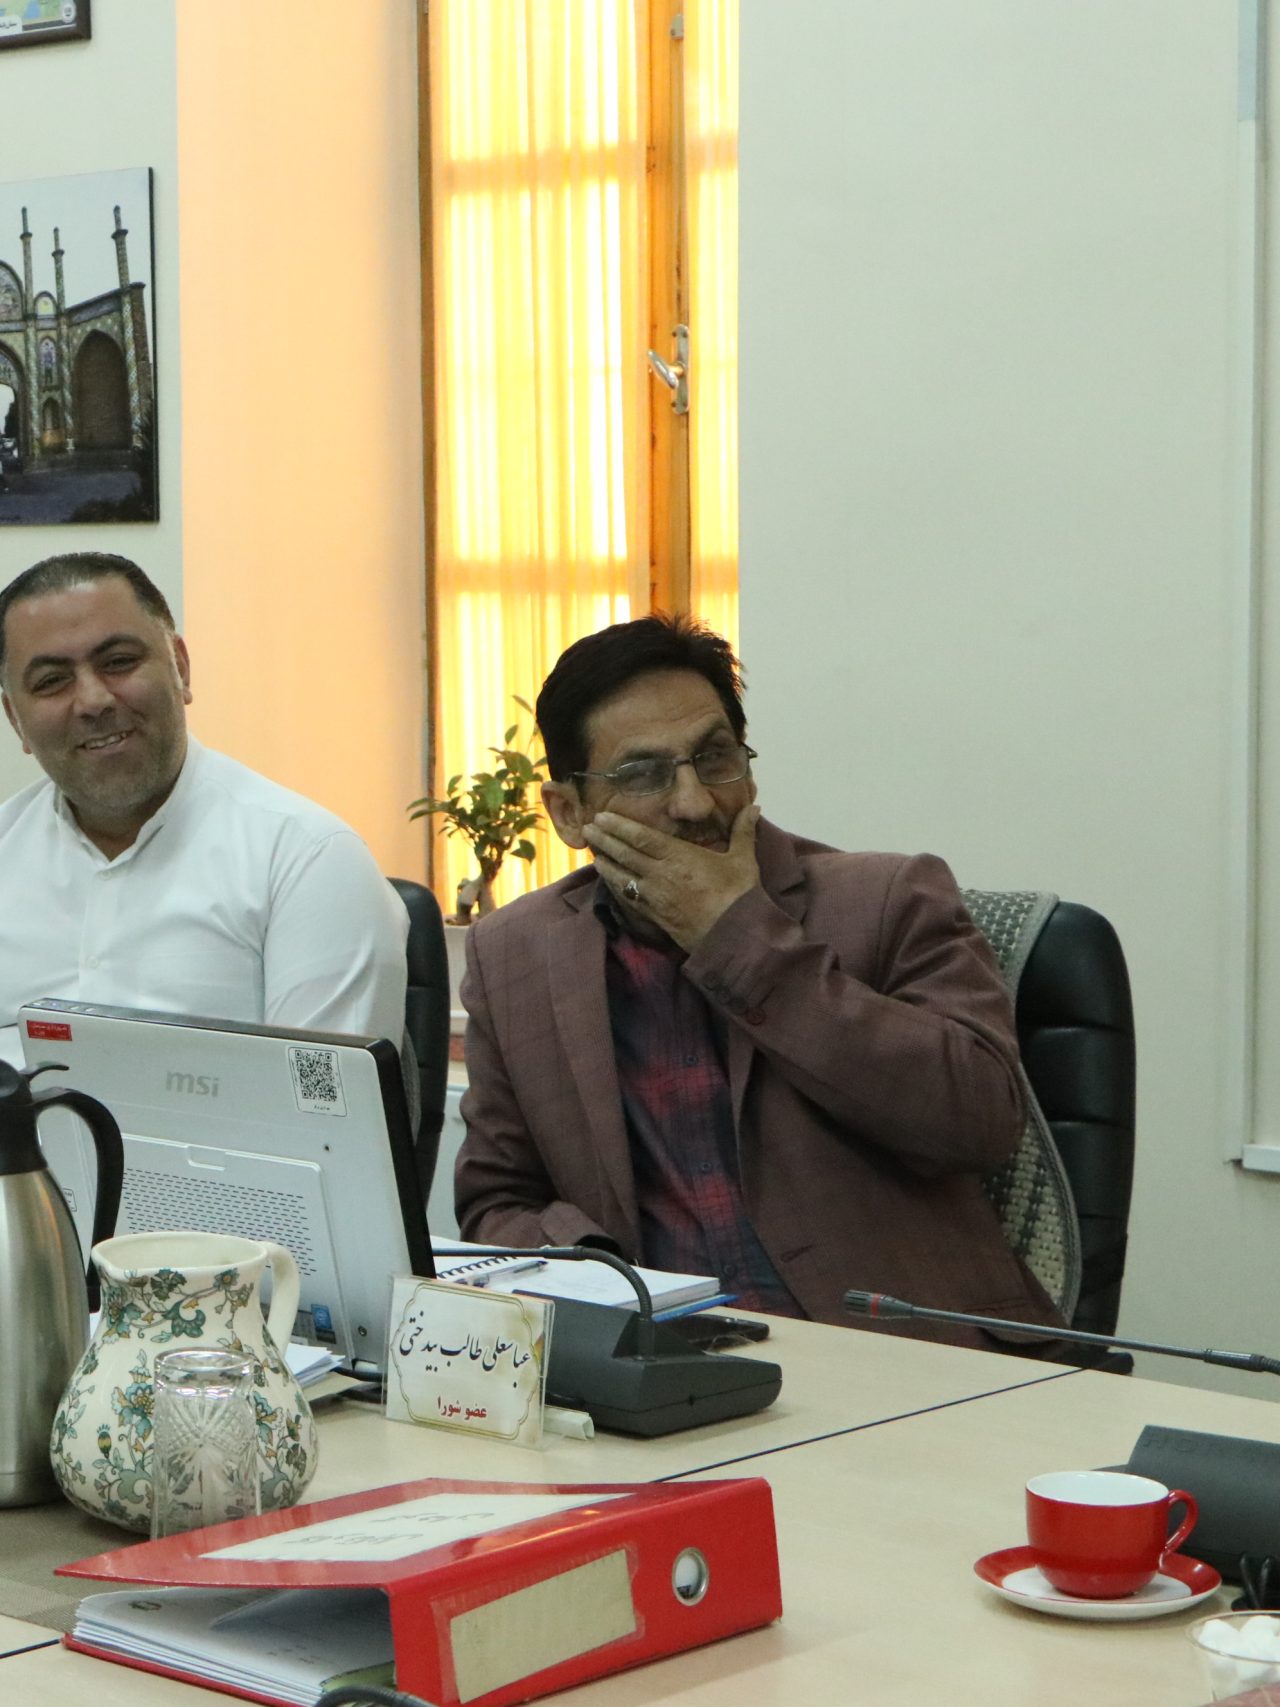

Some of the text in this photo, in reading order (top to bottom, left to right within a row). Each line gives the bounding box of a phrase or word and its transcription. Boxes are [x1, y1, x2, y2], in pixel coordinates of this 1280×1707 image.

[166, 1071, 219, 1098] msi
[399, 1310, 438, 1373] بیدختی
[439, 1332, 483, 1367] طالب
[436, 1395, 487, 1421] عضو شورا
